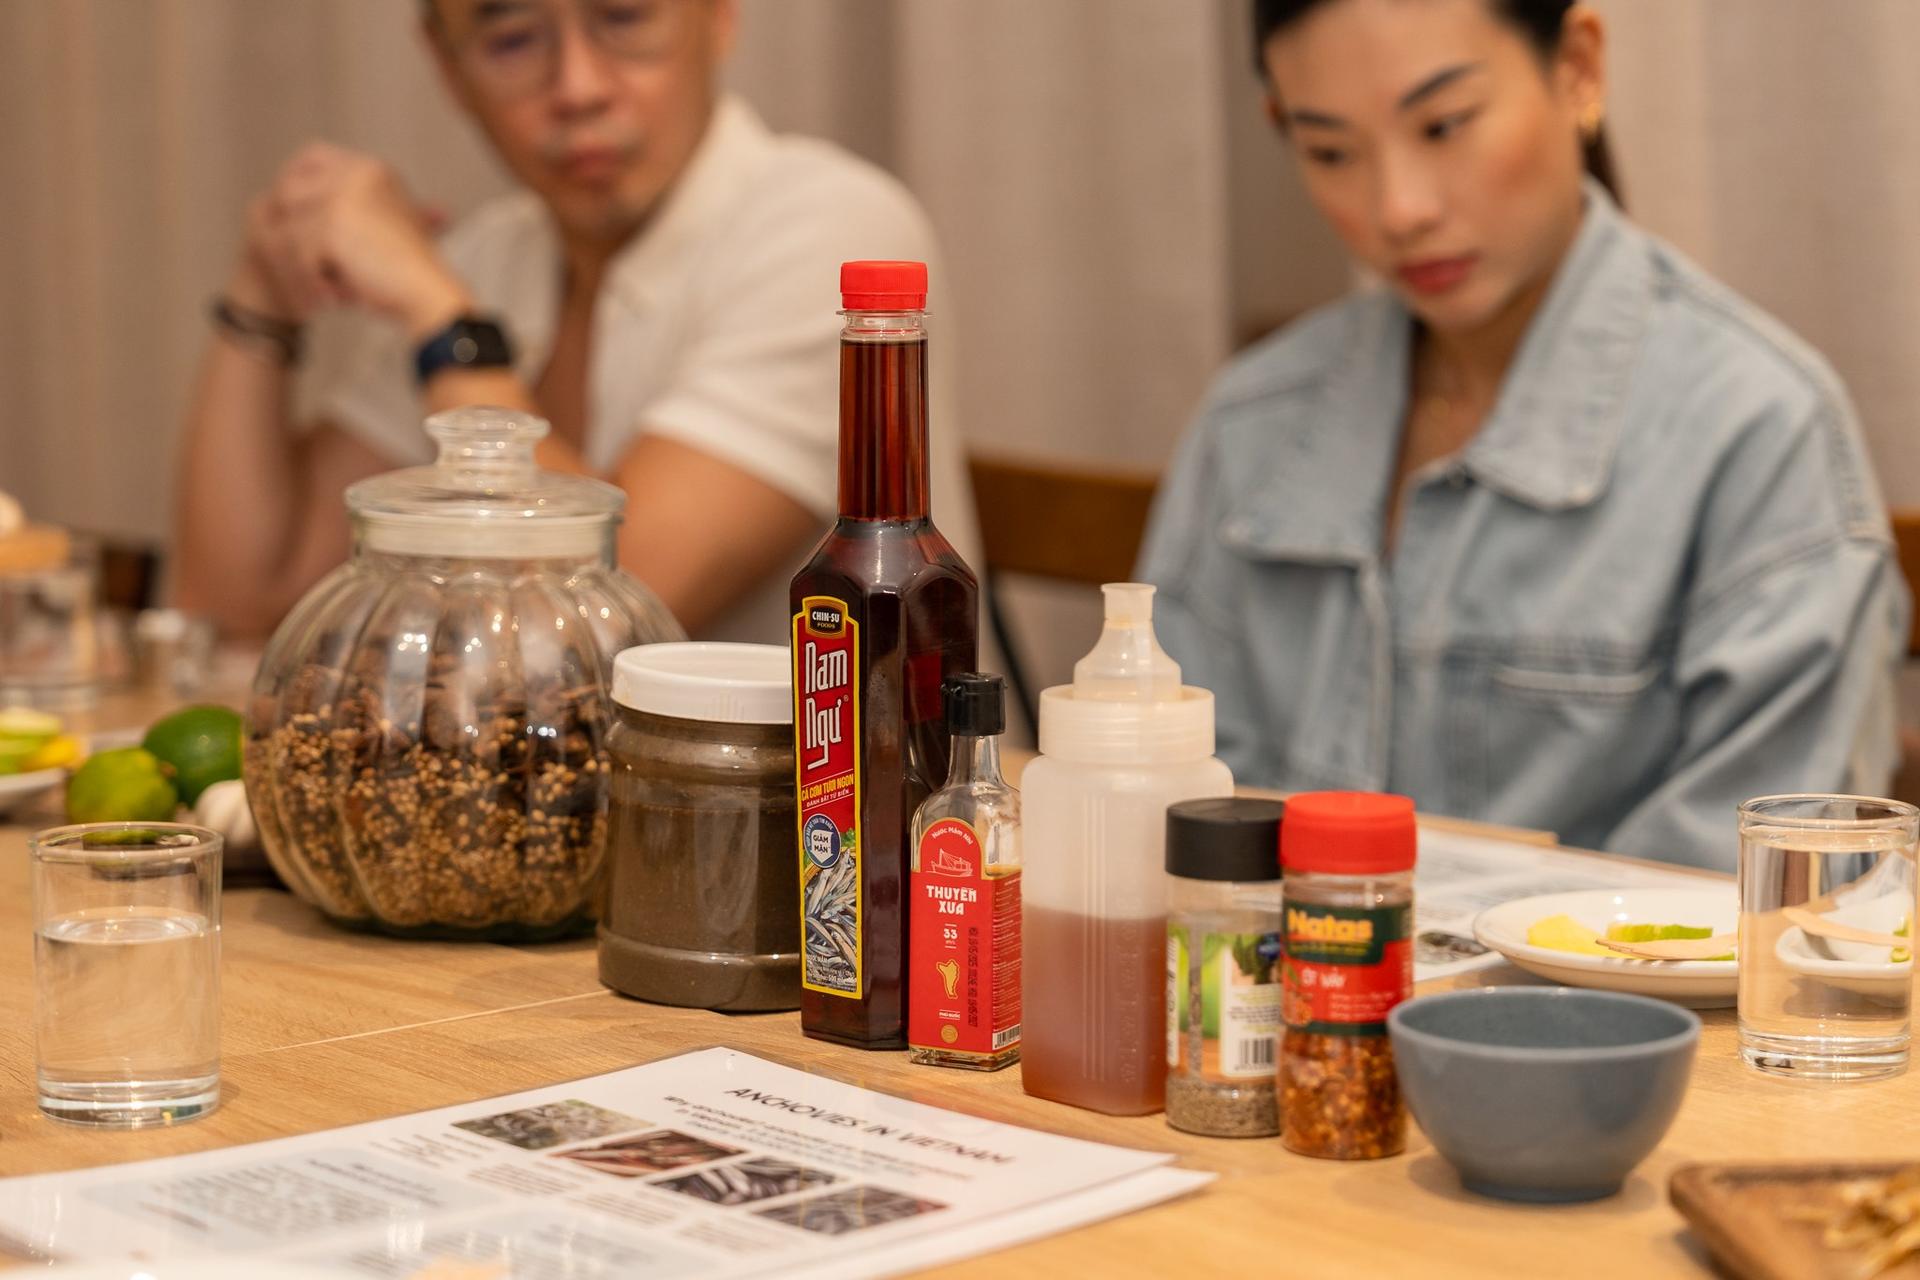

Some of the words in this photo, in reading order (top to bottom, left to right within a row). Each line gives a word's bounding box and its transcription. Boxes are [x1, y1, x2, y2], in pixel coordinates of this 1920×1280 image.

[812, 611, 840, 622] CHIN-SU
[805, 642, 847, 694] Nam
[836, 774, 853, 788] NGON
[943, 928, 957, 939] 33
[1288, 909, 1373, 943] Natas
[724, 1088, 867, 1127] ANCHOVIES
[863, 1124, 898, 1136] IN
[899, 1132, 1015, 1163] VIETNAM
